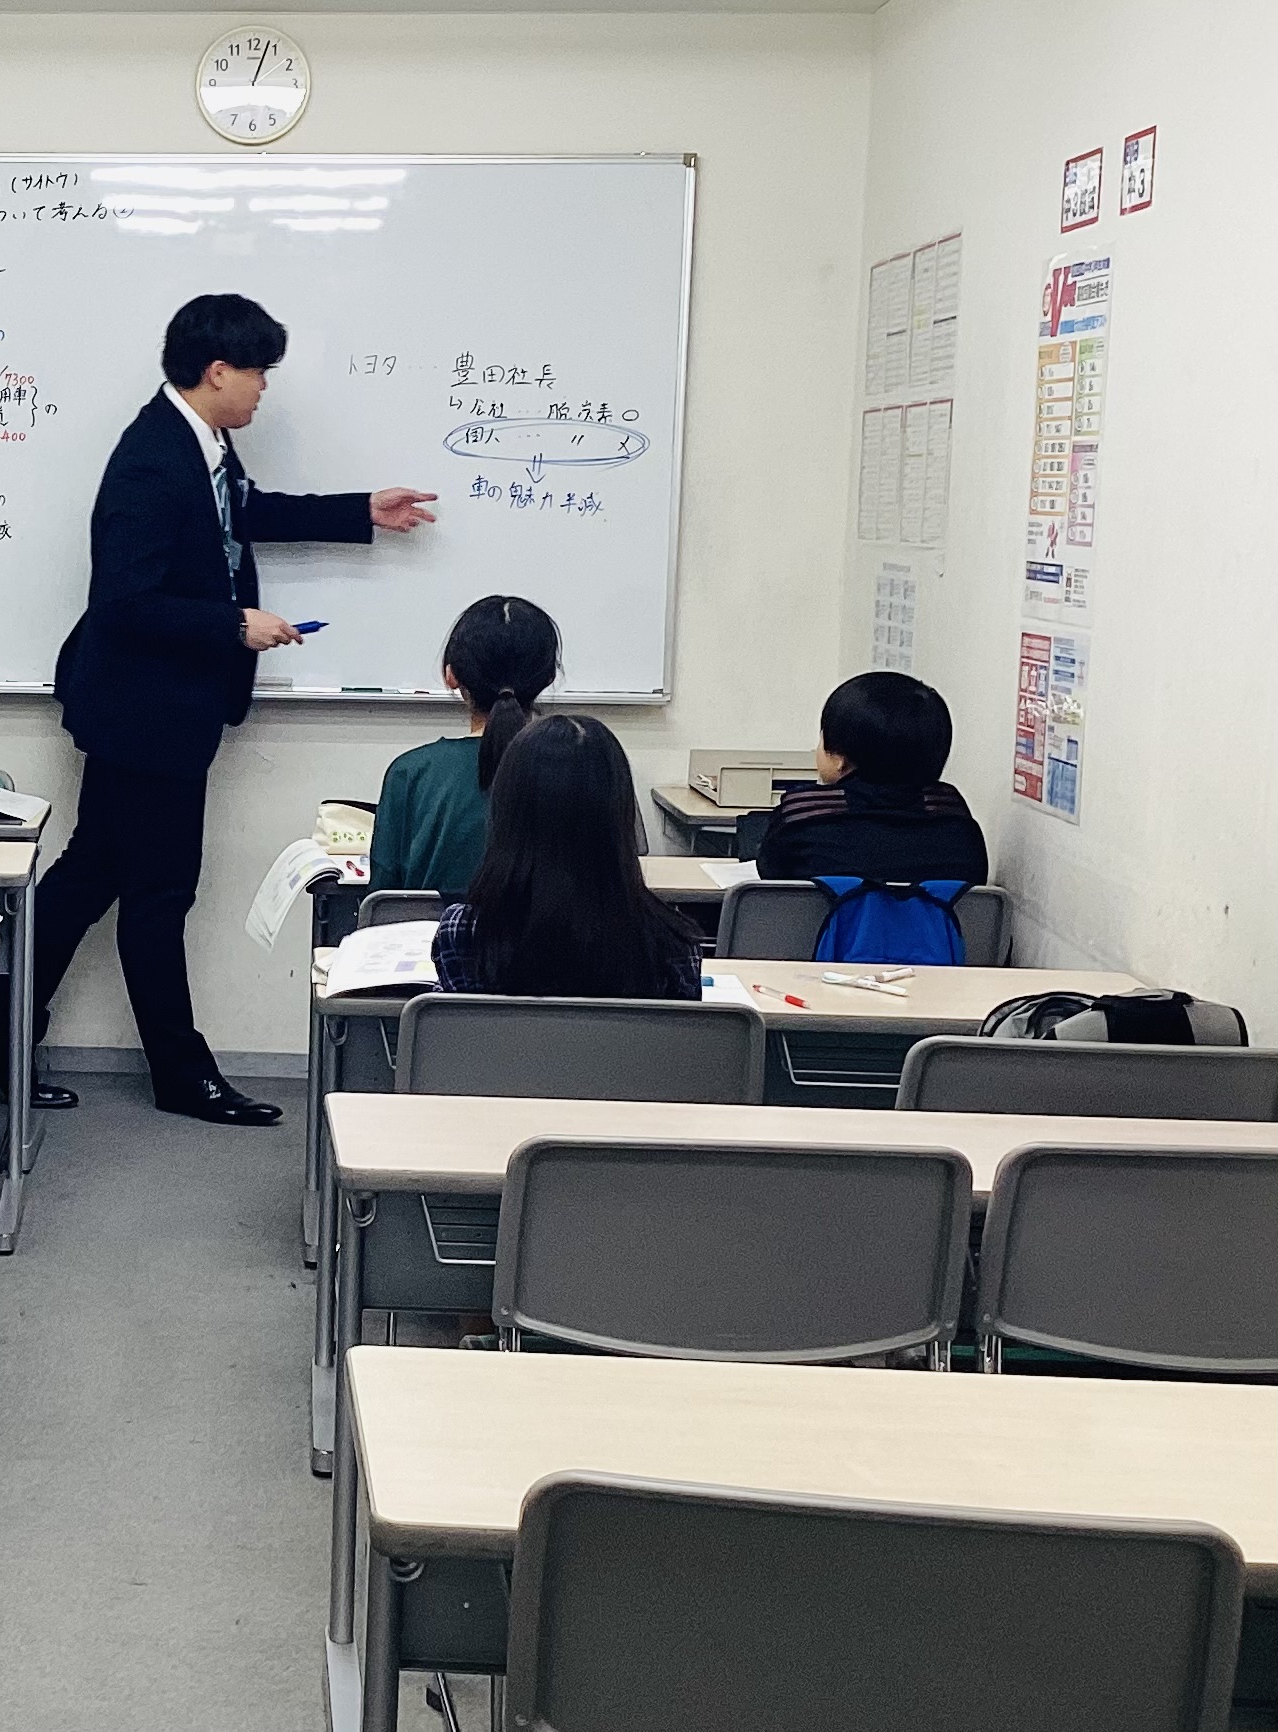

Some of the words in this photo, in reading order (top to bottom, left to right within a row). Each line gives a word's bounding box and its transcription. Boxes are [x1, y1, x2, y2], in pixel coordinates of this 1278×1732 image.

[228, 43, 240, 56] 11
[246, 37, 261, 51] 12
[272, 43, 278, 56] 1
[214, 58, 229, 71] 10
[285, 58, 294, 71] 2
[230, 113, 238, 126] 7
[248, 118, 257, 131] 6
[268, 113, 276, 126] 5
[348, 353, 399, 376] トヨタ
[450, 351, 557, 390] 豊田社長
